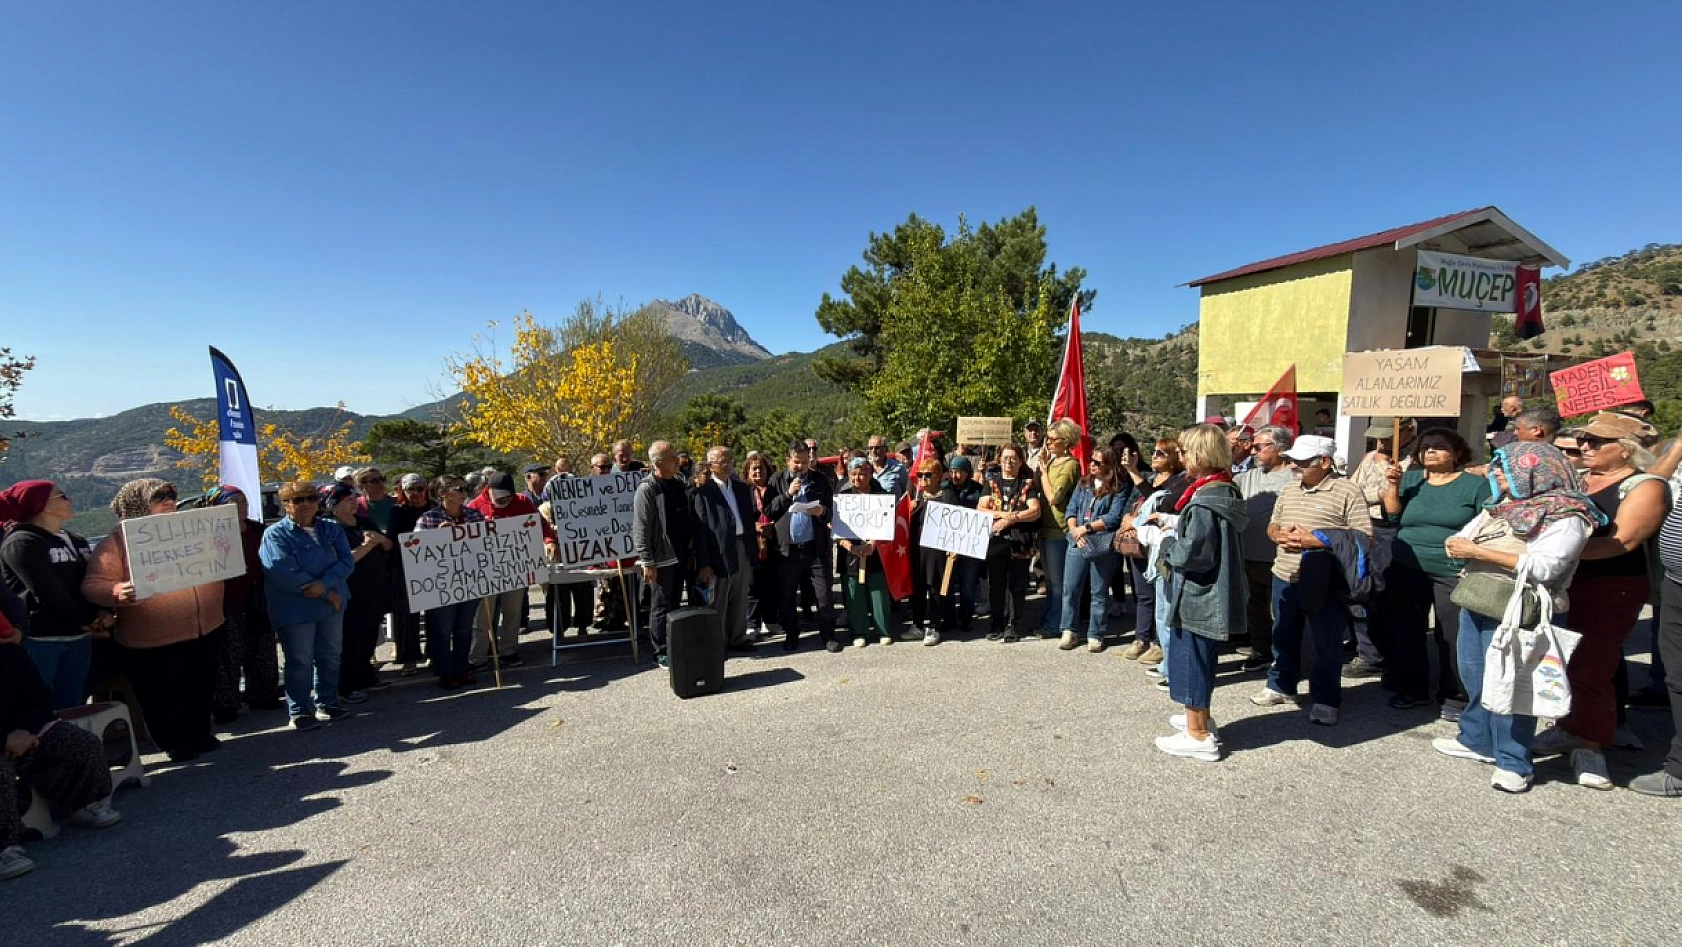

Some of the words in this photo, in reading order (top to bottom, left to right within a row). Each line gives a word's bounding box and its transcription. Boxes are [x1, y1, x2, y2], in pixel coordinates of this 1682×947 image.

[1438, 267, 1516, 308] MUÇEP
[1375, 356, 1430, 372] YAŞAM
[1554, 361, 1610, 388] MADEN
[1354, 374, 1443, 390] ALANLARIMIZ
[550, 478, 595, 501] NENEM
[598, 485, 614, 495] ve
[452, 521, 499, 541] DUR
[564, 521, 588, 540] Su
[595, 526, 611, 537] ve
[926, 503, 990, 537] KROMA
[140, 542, 204, 567] HERKES
[408, 540, 472, 564] YAYLA
[564, 536, 619, 565] UZAK
[437, 557, 465, 577] SU
